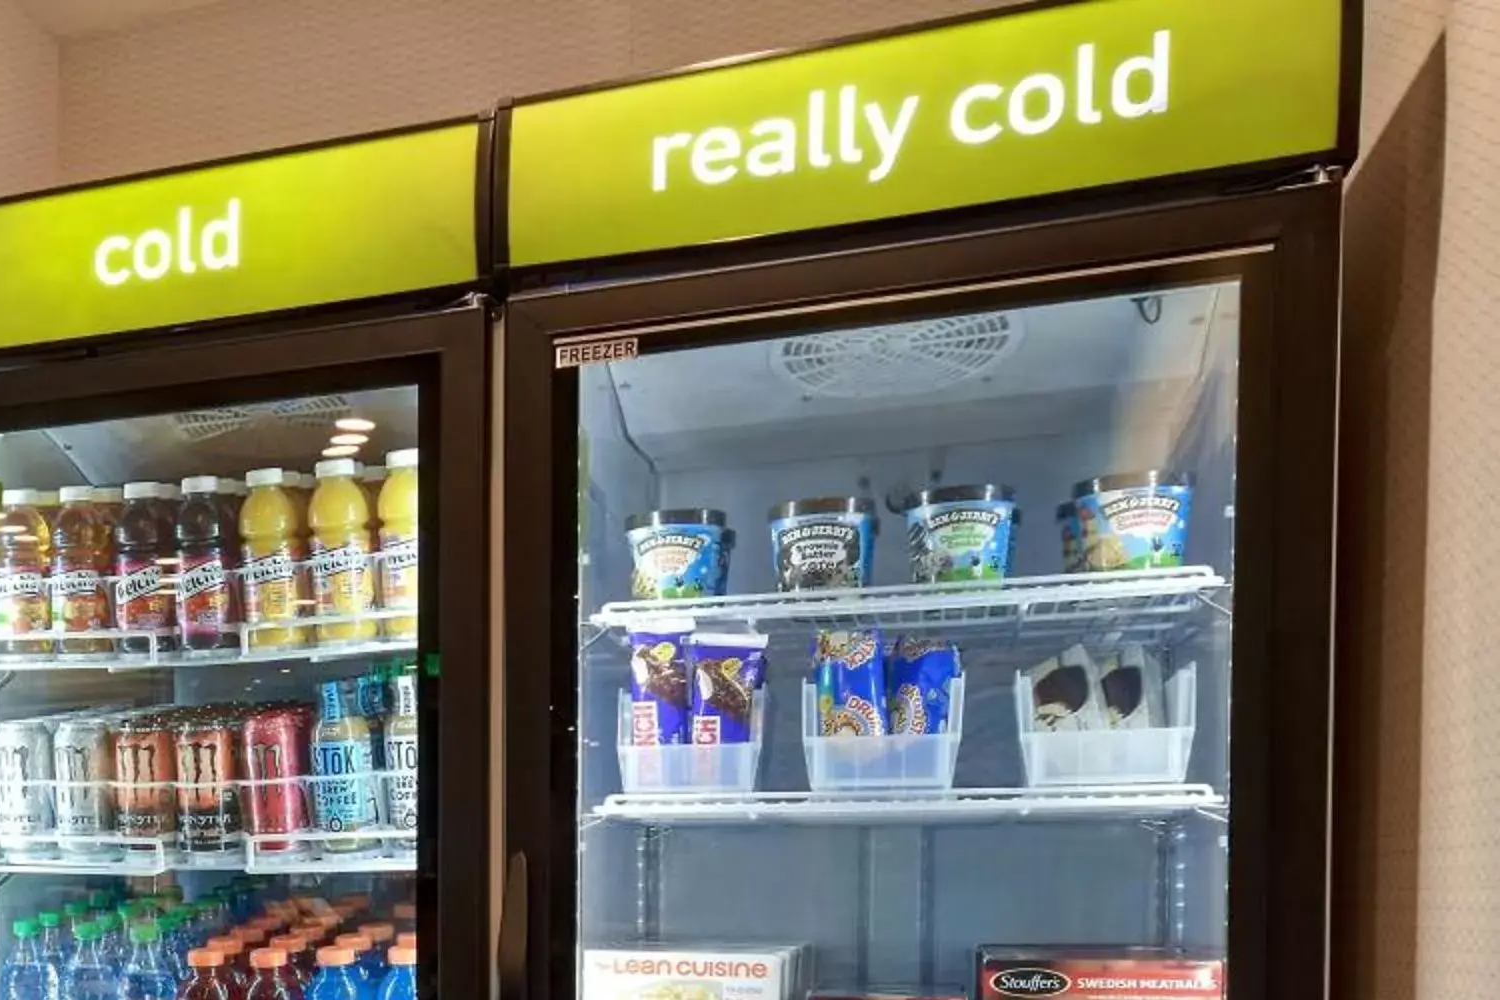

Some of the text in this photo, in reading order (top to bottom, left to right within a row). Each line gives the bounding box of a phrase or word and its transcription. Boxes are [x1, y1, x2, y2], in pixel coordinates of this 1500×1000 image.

[651, 29, 1171, 192] really cold
[94, 197, 241, 286] cold
[560, 341, 635, 363] FREEZER
[613, 958, 672, 976] Lean
[1000, 975, 1062, 993] Stouffer's
[1077, 977, 1137, 989] SWEDISH
